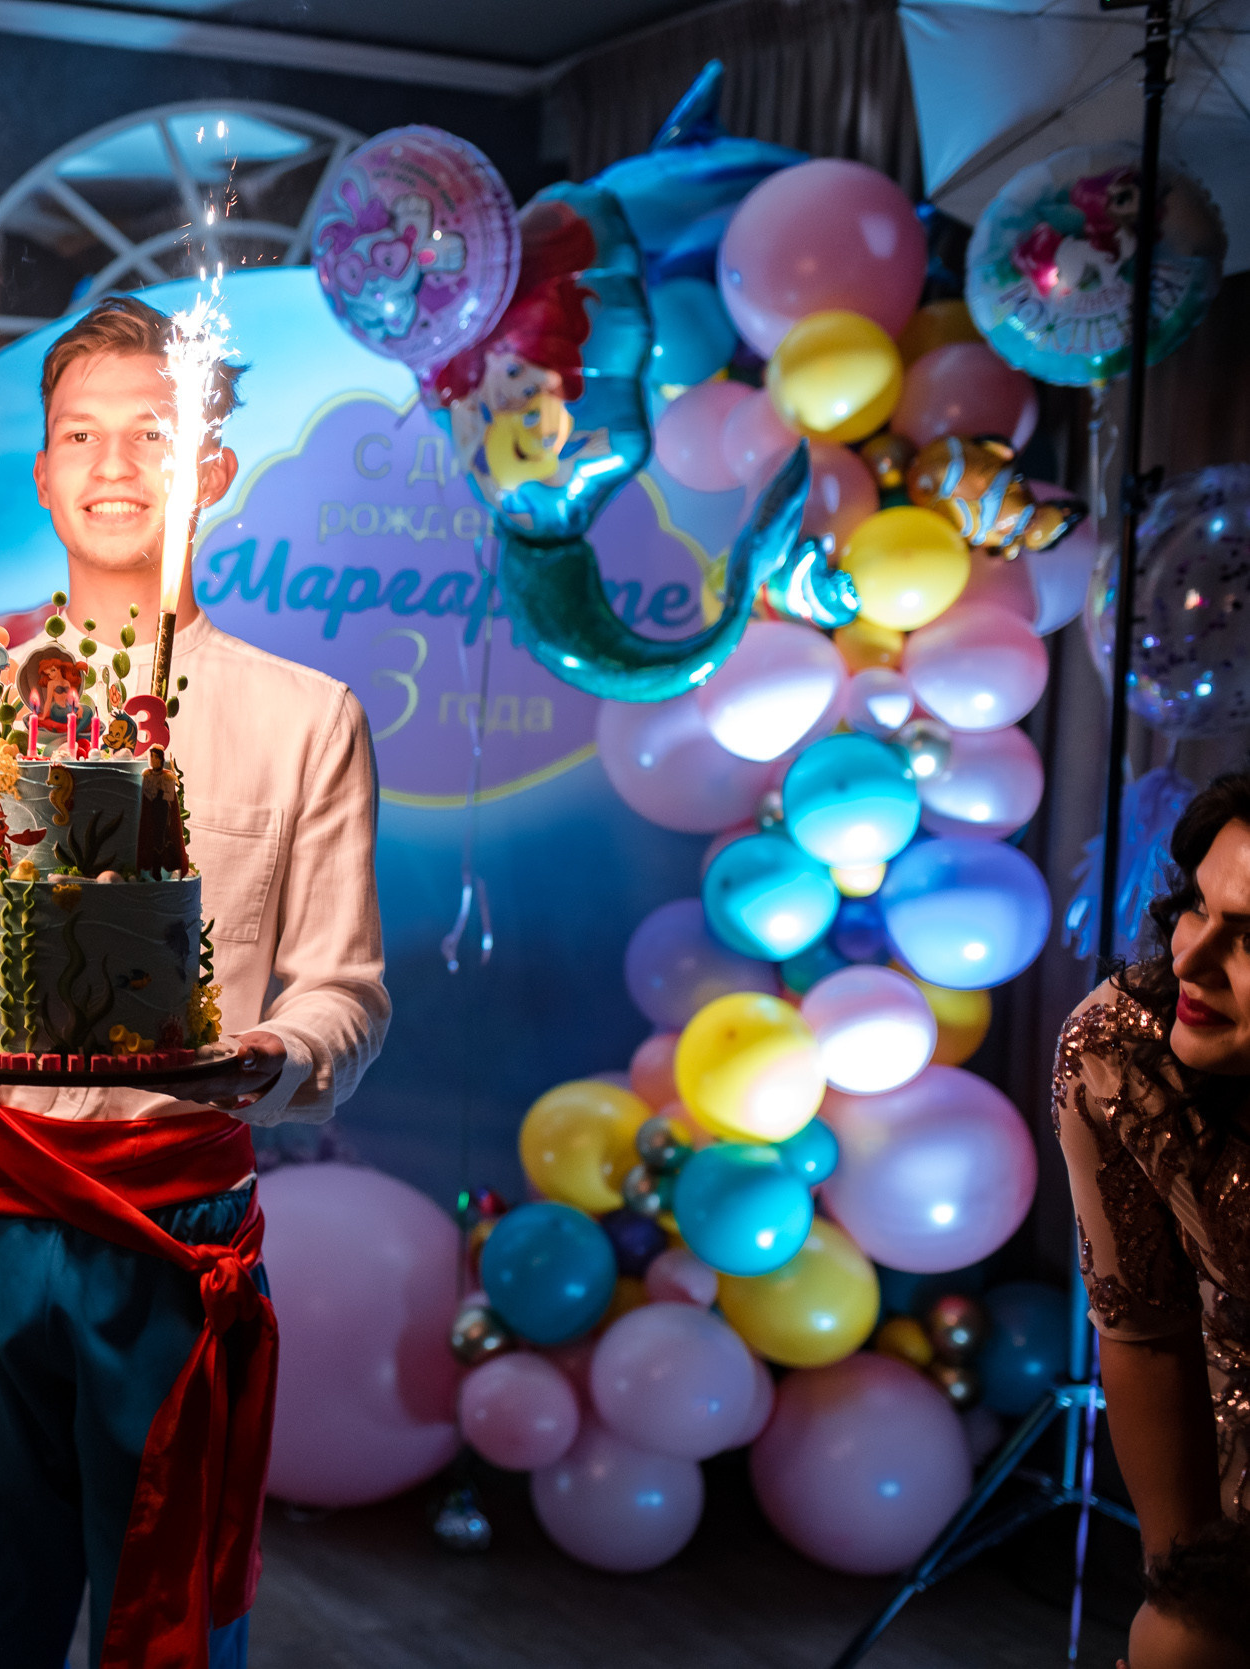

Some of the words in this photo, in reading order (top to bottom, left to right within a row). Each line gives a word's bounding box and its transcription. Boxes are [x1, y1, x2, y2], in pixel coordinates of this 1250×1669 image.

[196, 537, 701, 646] Маргаре
[123, 694, 171, 757] 3
[370, 627, 428, 739] 3
[438, 690, 554, 738] года
